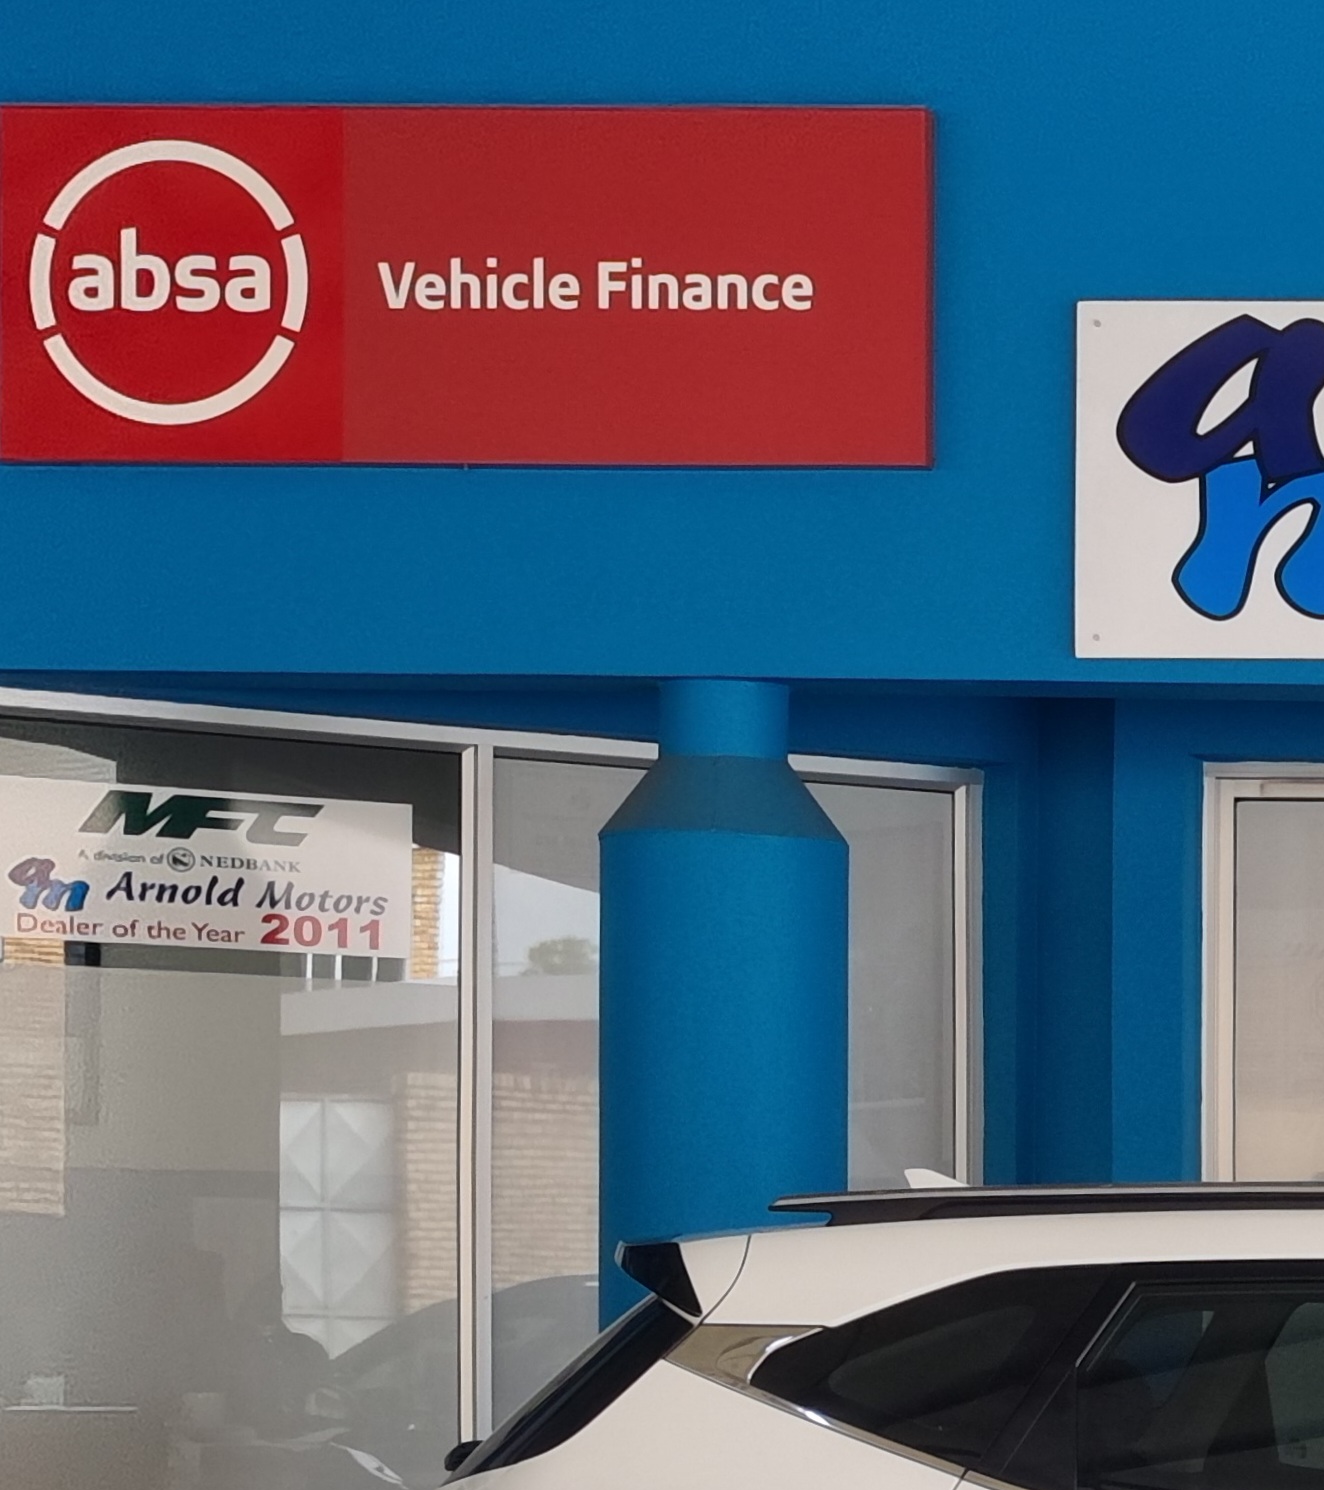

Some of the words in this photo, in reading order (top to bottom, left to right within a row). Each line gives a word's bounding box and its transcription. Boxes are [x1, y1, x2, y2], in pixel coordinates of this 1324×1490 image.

[68, 227, 271, 313] absa
[377, 256, 580, 310] Vehicle
[597, 257, 815, 311] Finance
[78, 789, 325, 847] MFC
[200, 854, 302, 874] NEDBANK
[105, 871, 245, 909] Arnold
[255, 880, 390, 916] Motors
[16, 912, 104, 936] Dealer
[112, 919, 140, 938] of
[147, 921, 187, 941] the
[191, 921, 246, 944] Year
[260, 913, 381, 951] 2011
